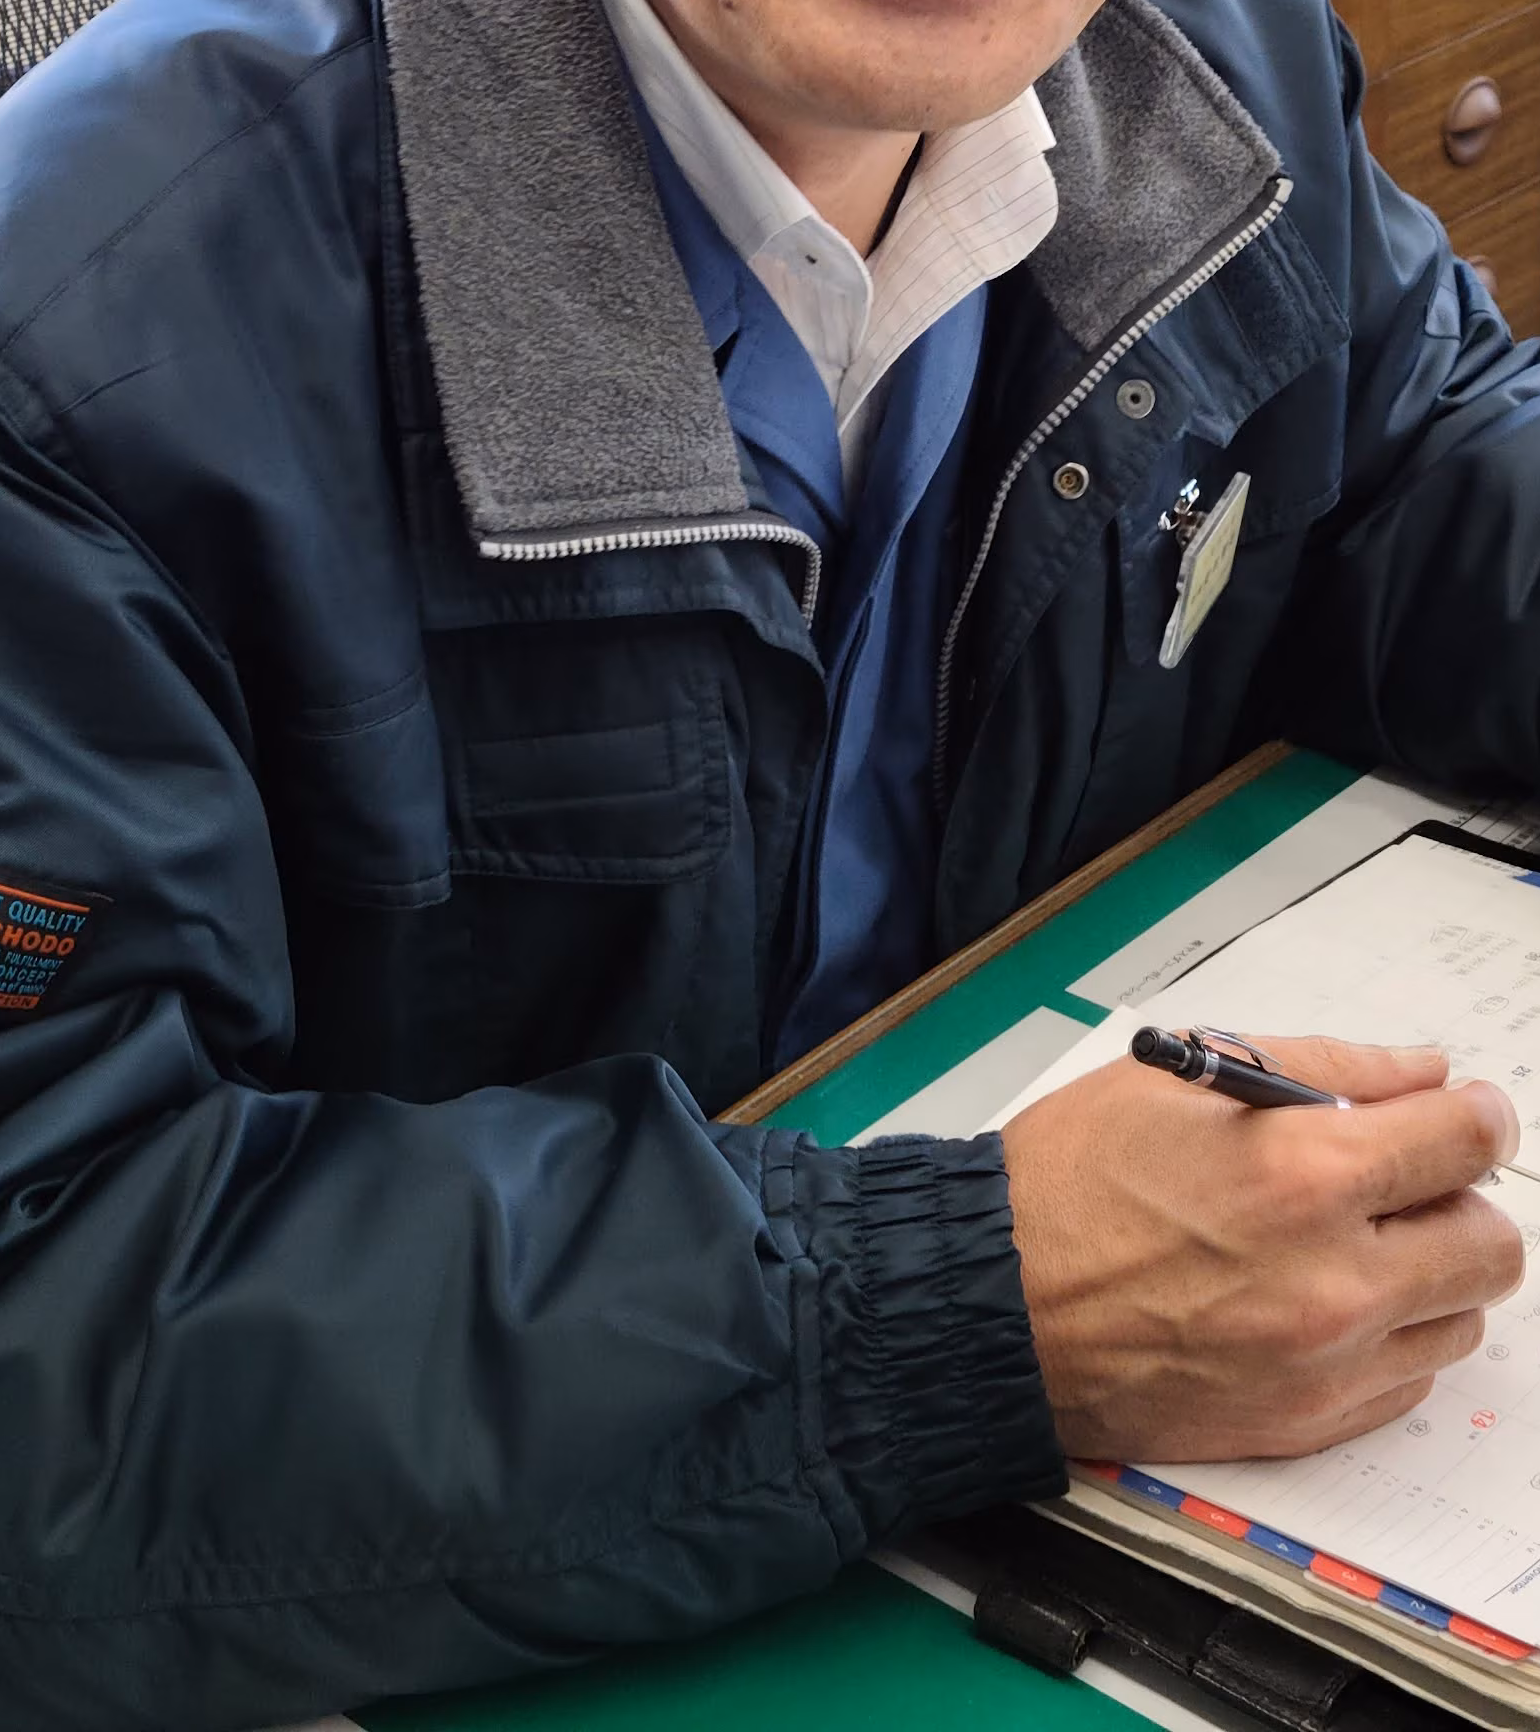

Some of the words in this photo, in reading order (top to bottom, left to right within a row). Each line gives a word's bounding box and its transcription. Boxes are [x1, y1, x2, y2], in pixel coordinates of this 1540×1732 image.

[9, 901, 86, 933] QUALITY
[5, 951, 64, 970] FULFILLMENT
[1471, 1411, 1493, 1427] 14
